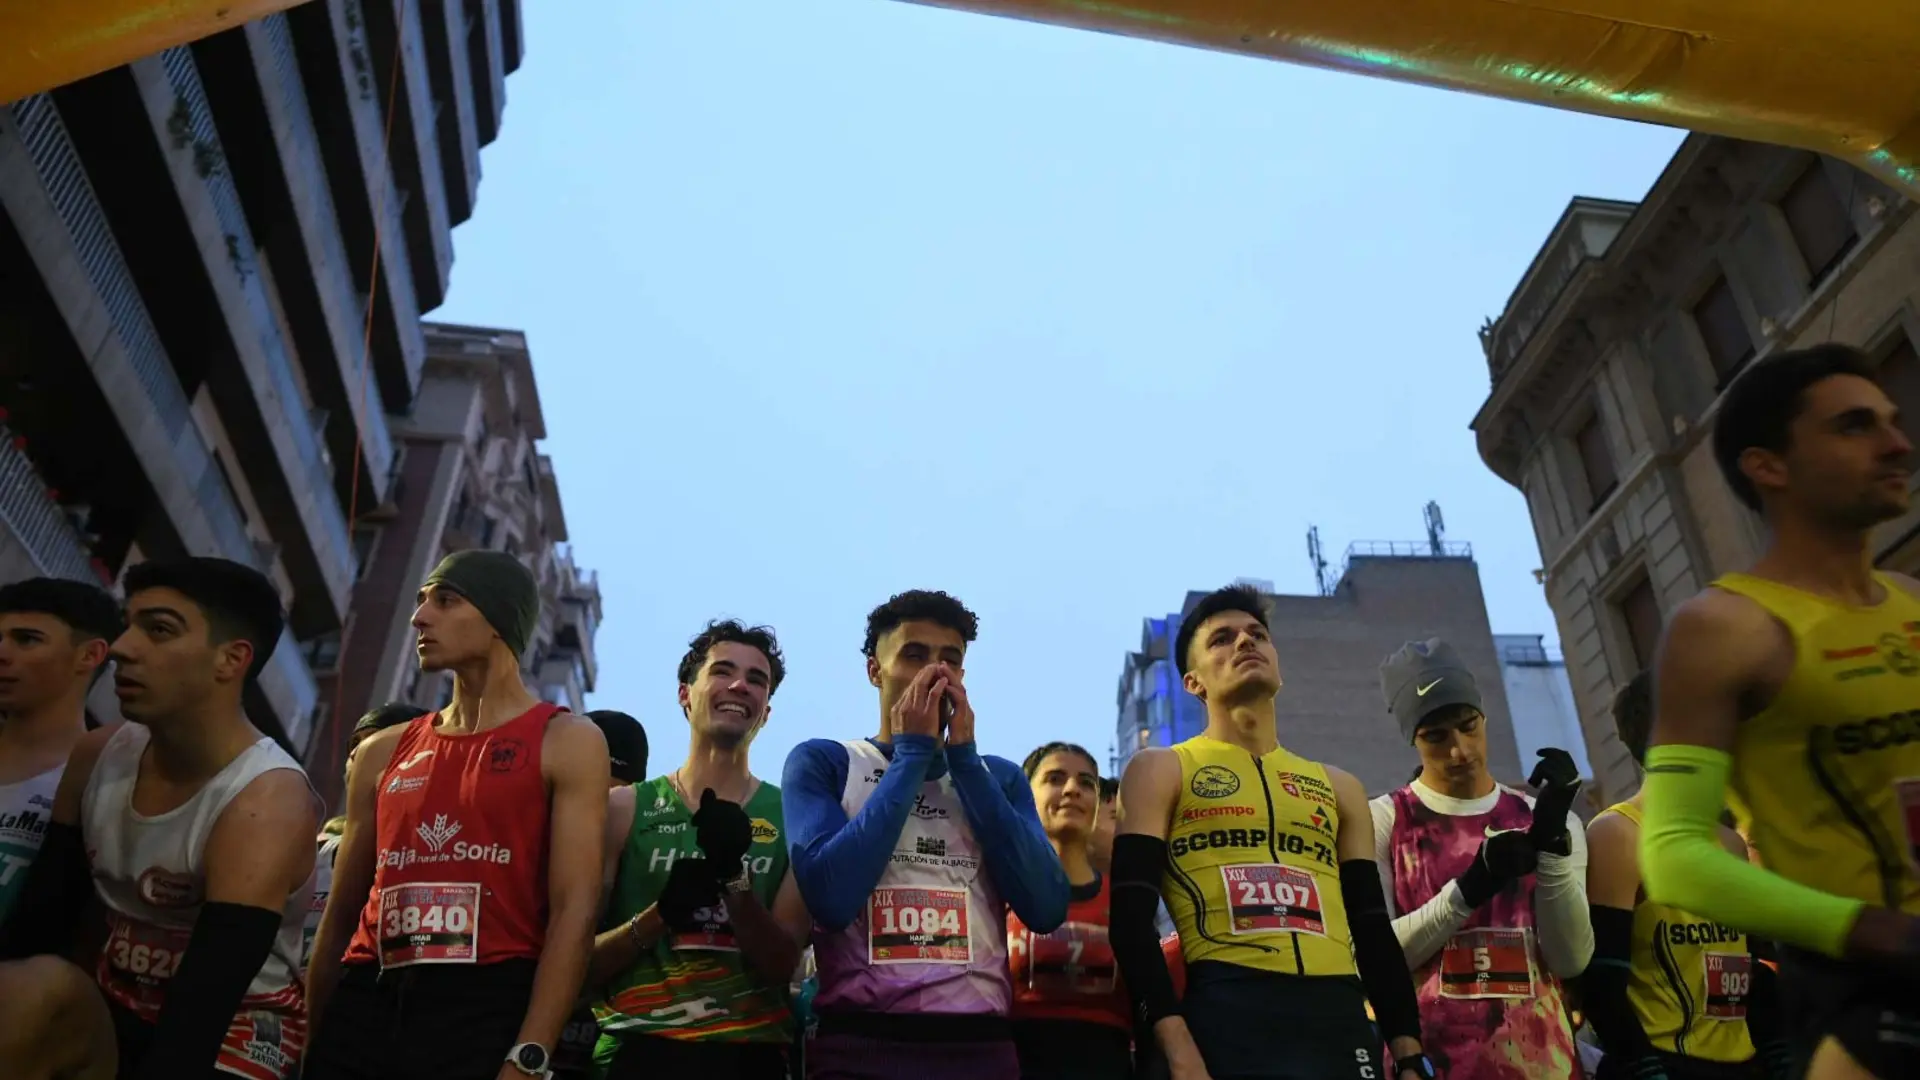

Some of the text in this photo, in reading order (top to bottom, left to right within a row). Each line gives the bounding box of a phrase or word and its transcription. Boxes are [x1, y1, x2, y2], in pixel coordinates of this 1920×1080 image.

[376, 846, 416, 870] Caja
[452, 840, 511, 864] Soria
[941, 860, 978, 869] ALBACETE
[1227, 868, 1248, 881] XIX
[384, 891, 399, 910] XIX
[874, 891, 895, 908] XIX
[1238, 881, 1310, 908] 2107
[385, 905, 468, 938] 3840
[881, 906, 961, 935] 1084
[1067, 941, 1084, 964] 7
[1473, 947, 1491, 971] 5
[1708, 956, 1724, 971] XIX
[1721, 972, 1750, 996] 903
